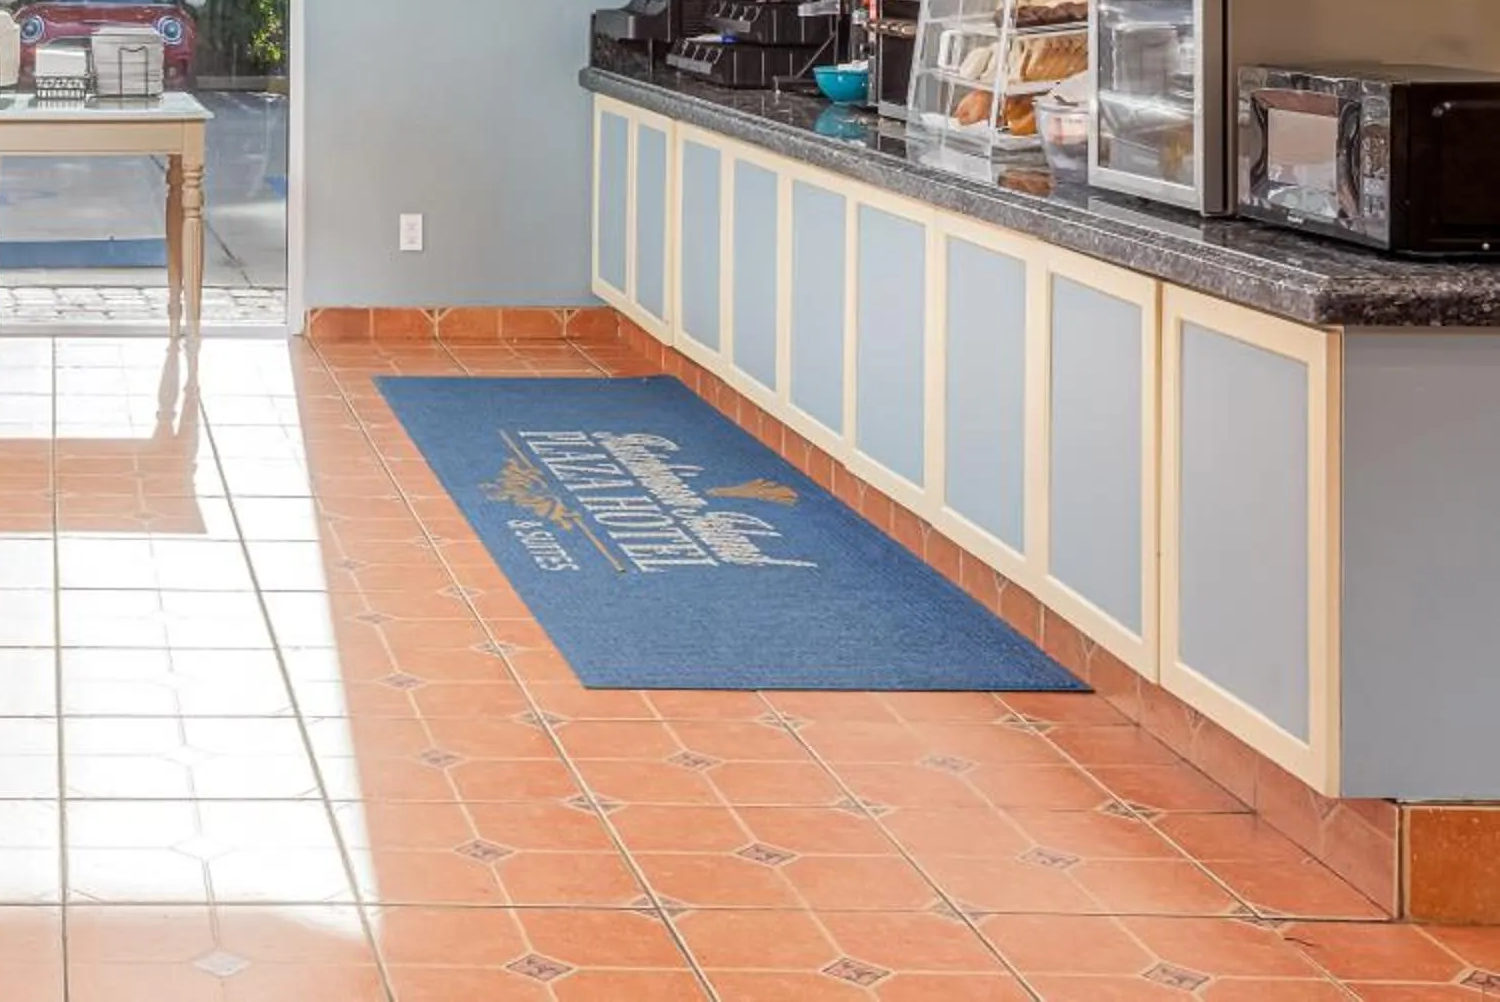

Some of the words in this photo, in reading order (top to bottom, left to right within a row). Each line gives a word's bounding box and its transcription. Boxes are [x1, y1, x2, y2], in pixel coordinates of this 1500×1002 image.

[507, 518, 543, 530] &
[518, 431, 635, 492] PLAZA
[577, 495, 721, 573] HOTEL
[515, 527, 581, 572] SUITES
